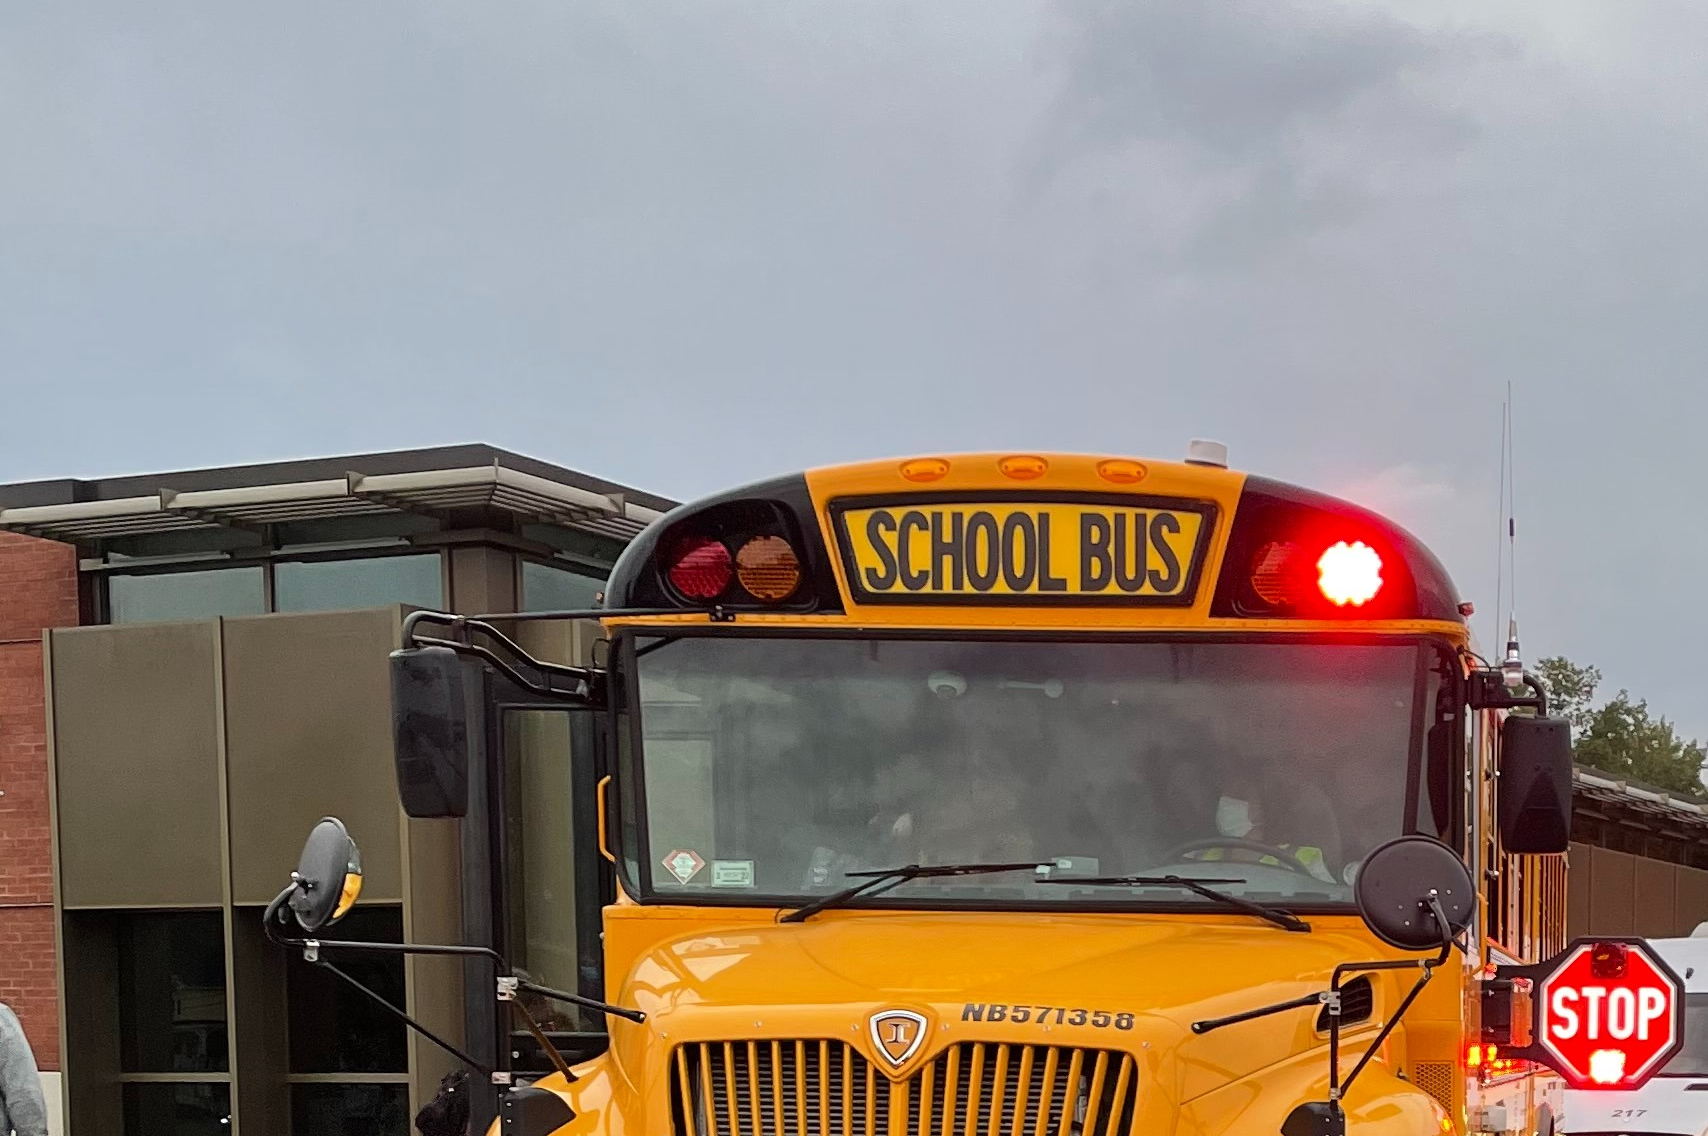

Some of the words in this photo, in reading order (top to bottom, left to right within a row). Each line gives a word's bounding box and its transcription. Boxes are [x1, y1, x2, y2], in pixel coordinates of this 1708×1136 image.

[865, 511, 1067, 592] SCHOOL
[1080, 512, 1181, 593] BUS
[961, 1003, 1135, 1031] NB571358
[1551, 986, 1666, 1041] STOP
[1611, 1109, 1648, 1118] 217
